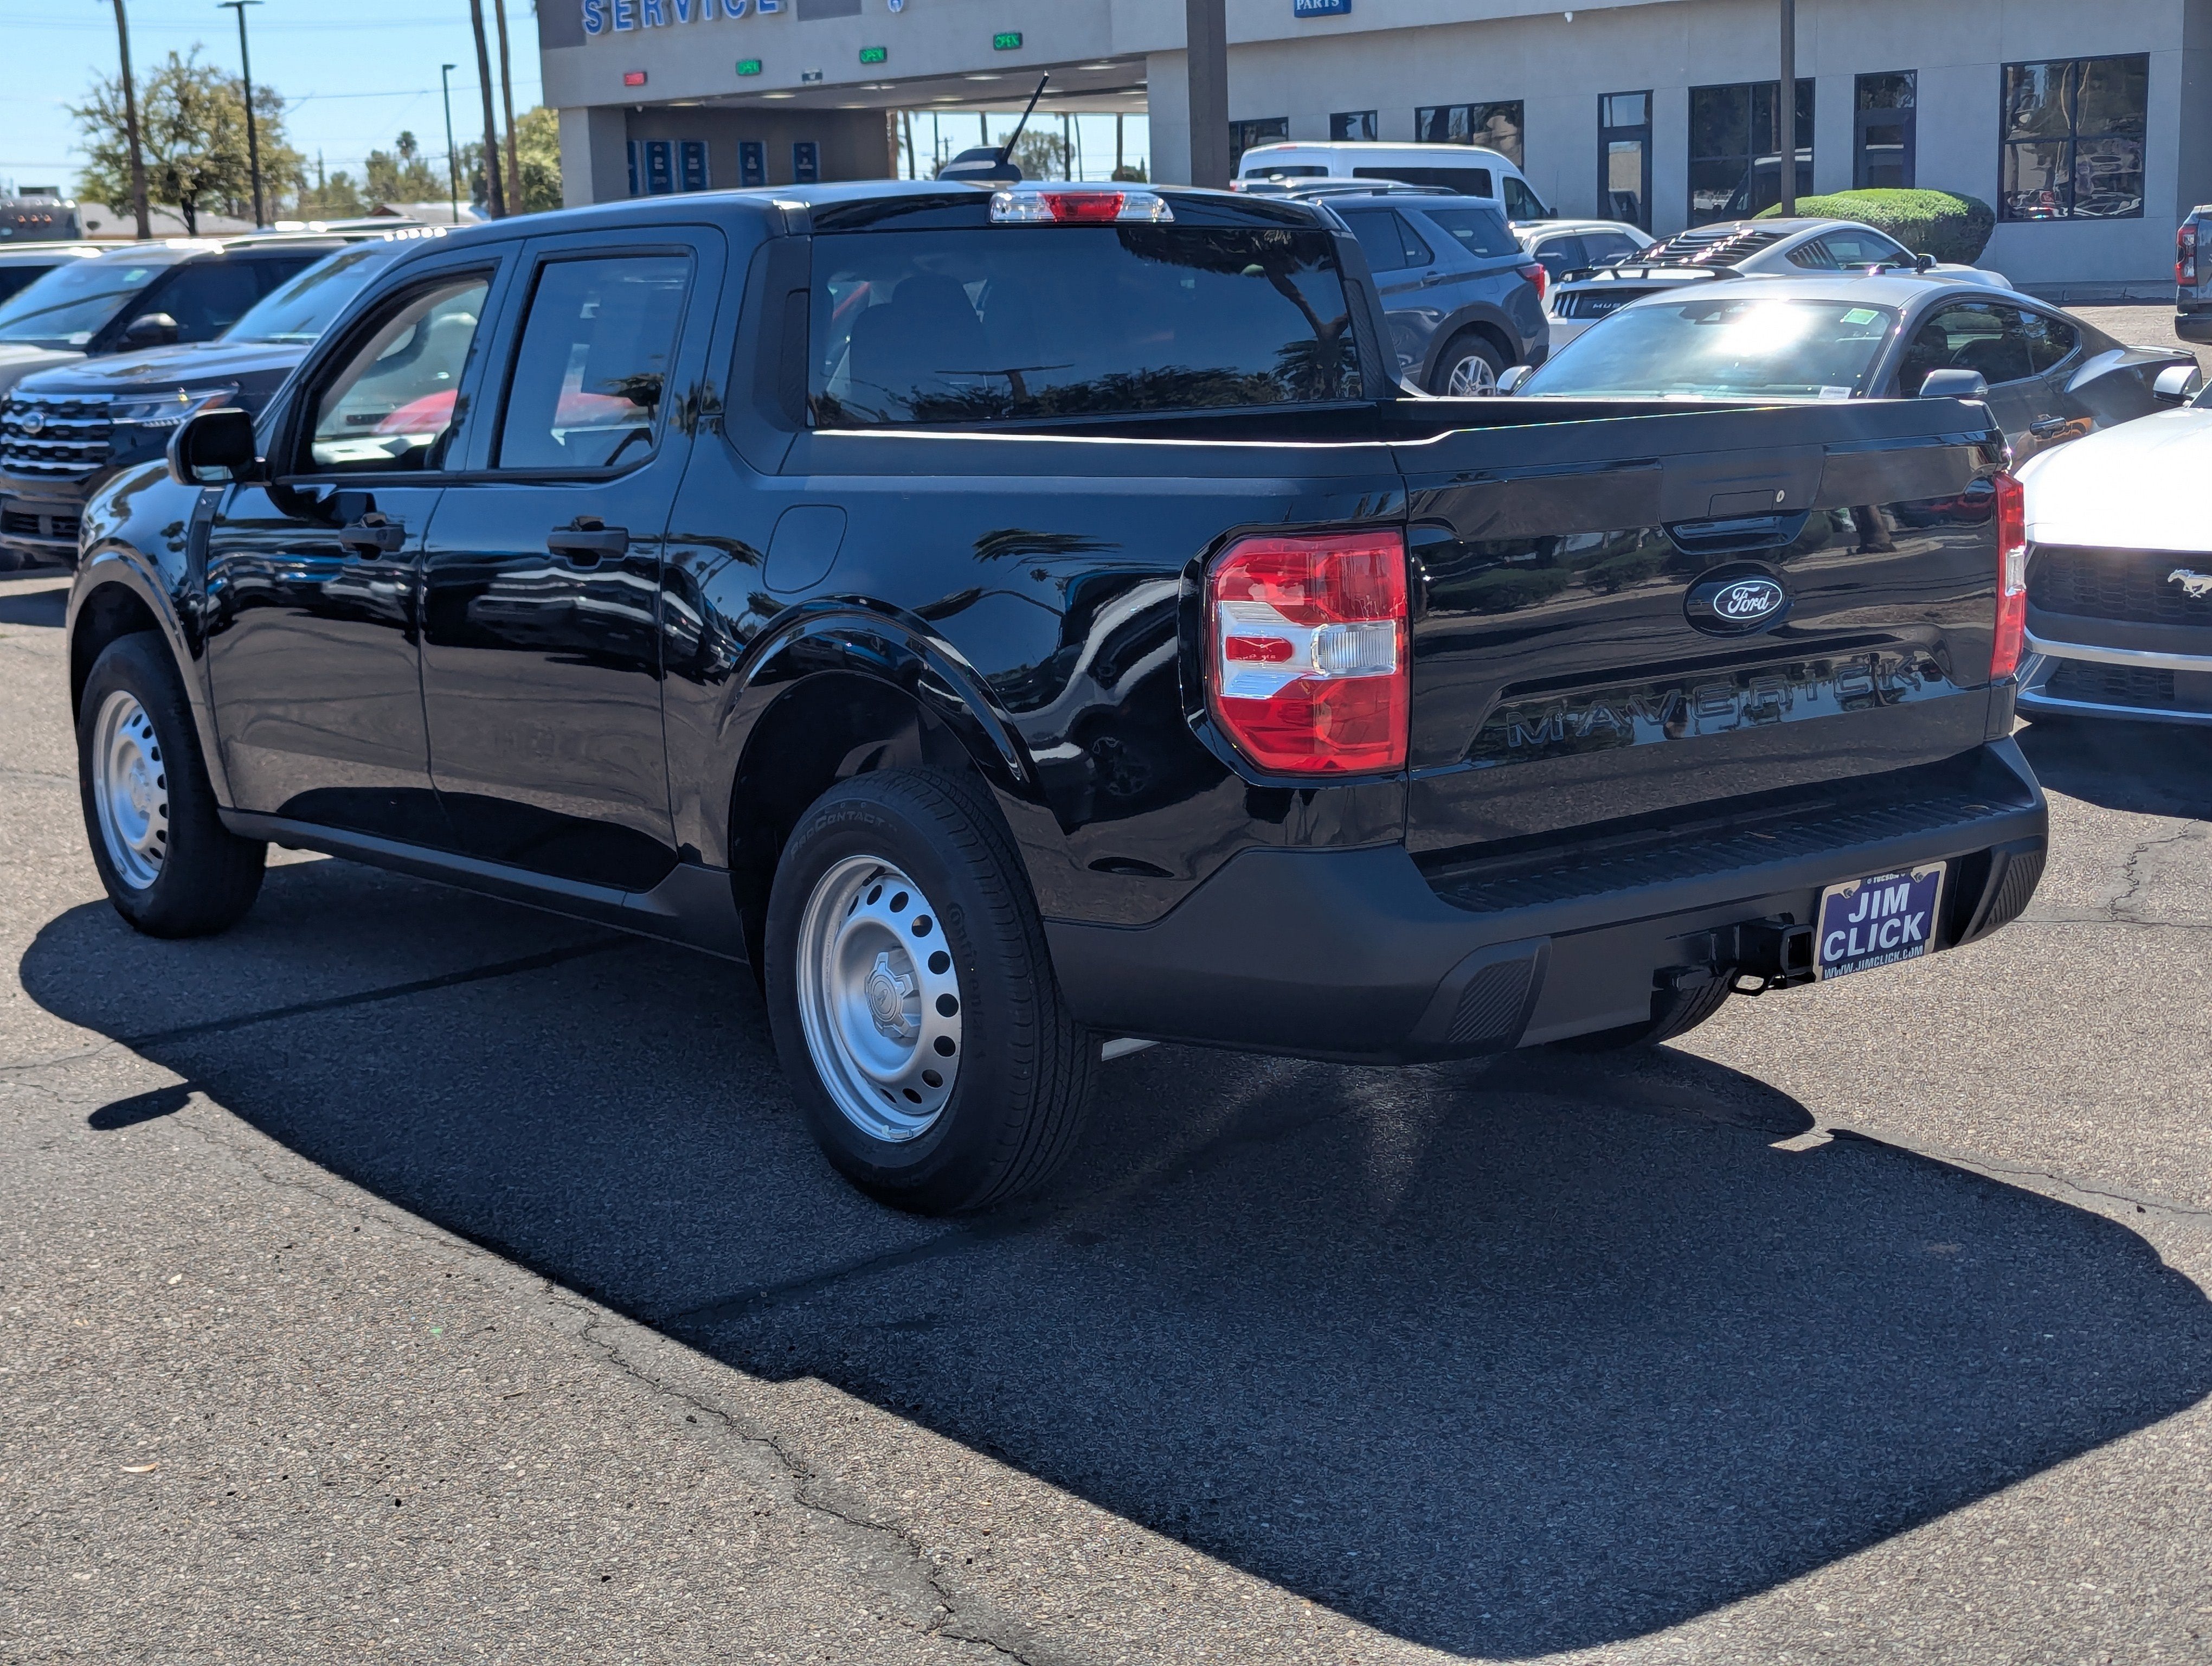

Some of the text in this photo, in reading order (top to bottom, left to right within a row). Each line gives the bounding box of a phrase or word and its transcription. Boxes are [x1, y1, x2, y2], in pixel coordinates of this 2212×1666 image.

[1727, 586, 1770, 613] Ford
[1506, 651, 1922, 748] MAVERICK
[1848, 882, 1911, 924] JIM
[1823, 911, 1925, 962] CLICK
